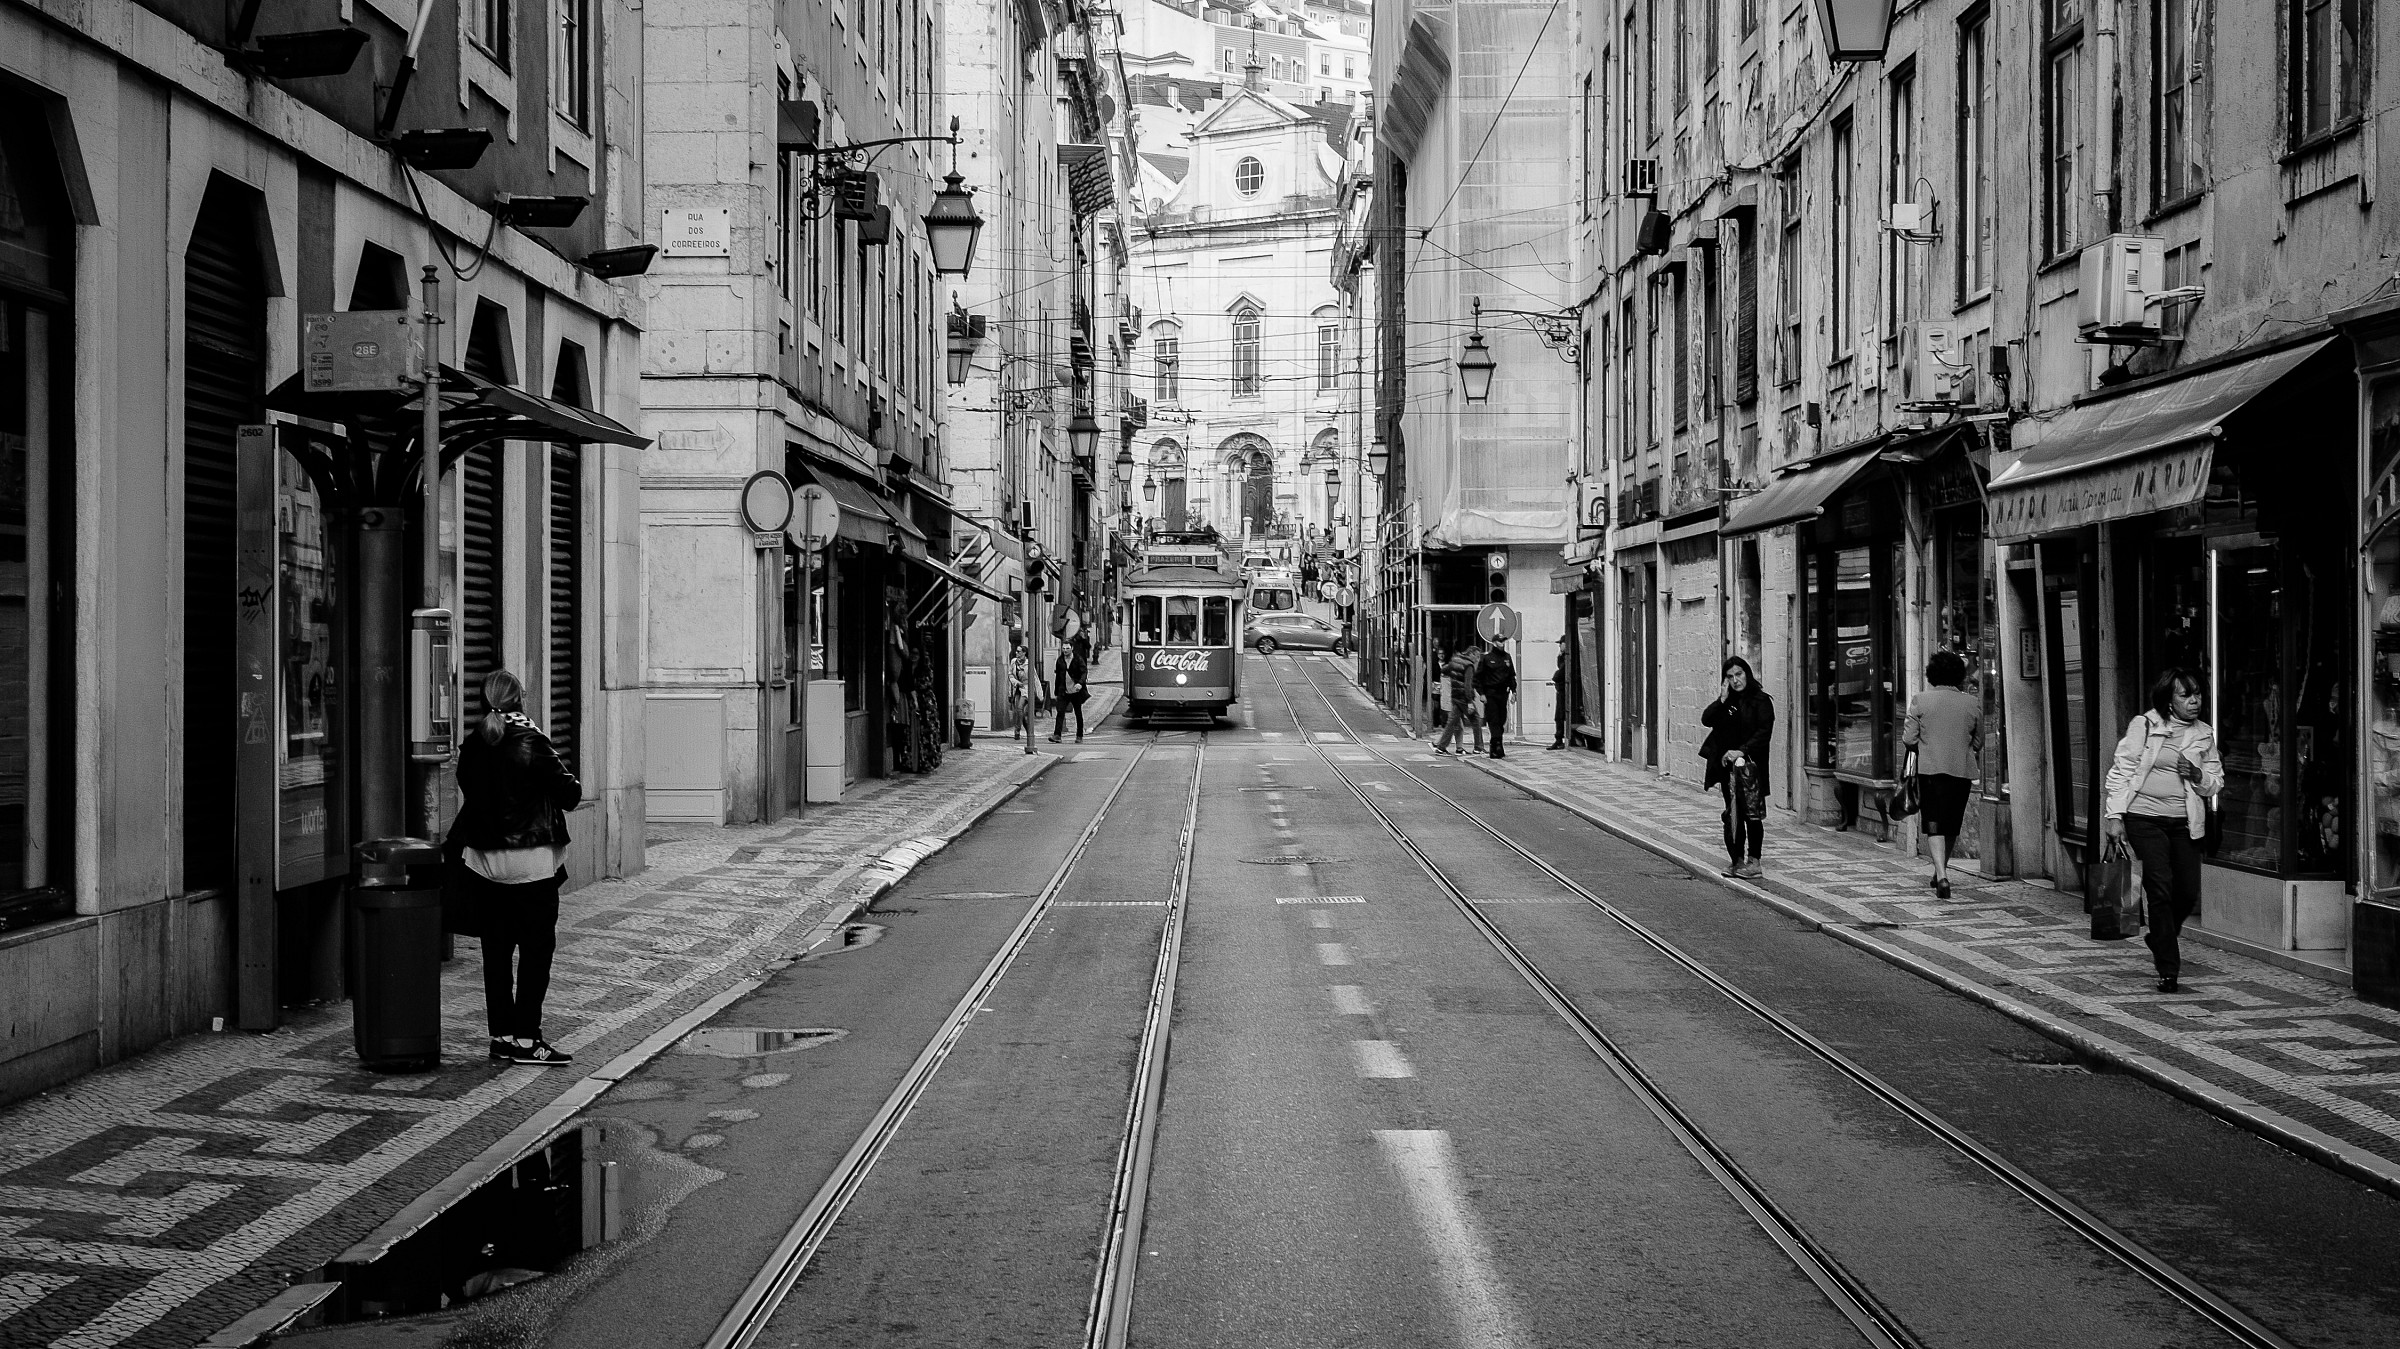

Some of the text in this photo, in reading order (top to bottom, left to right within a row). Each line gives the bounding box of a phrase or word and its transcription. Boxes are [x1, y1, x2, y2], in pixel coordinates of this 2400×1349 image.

[687, 213, 704, 221] RUA
[688, 226, 704, 235] DOS
[671, 240, 721, 248] CORREEIROS
[355, 345, 377, 355] 28E
[240, 428, 264, 437] 2602
